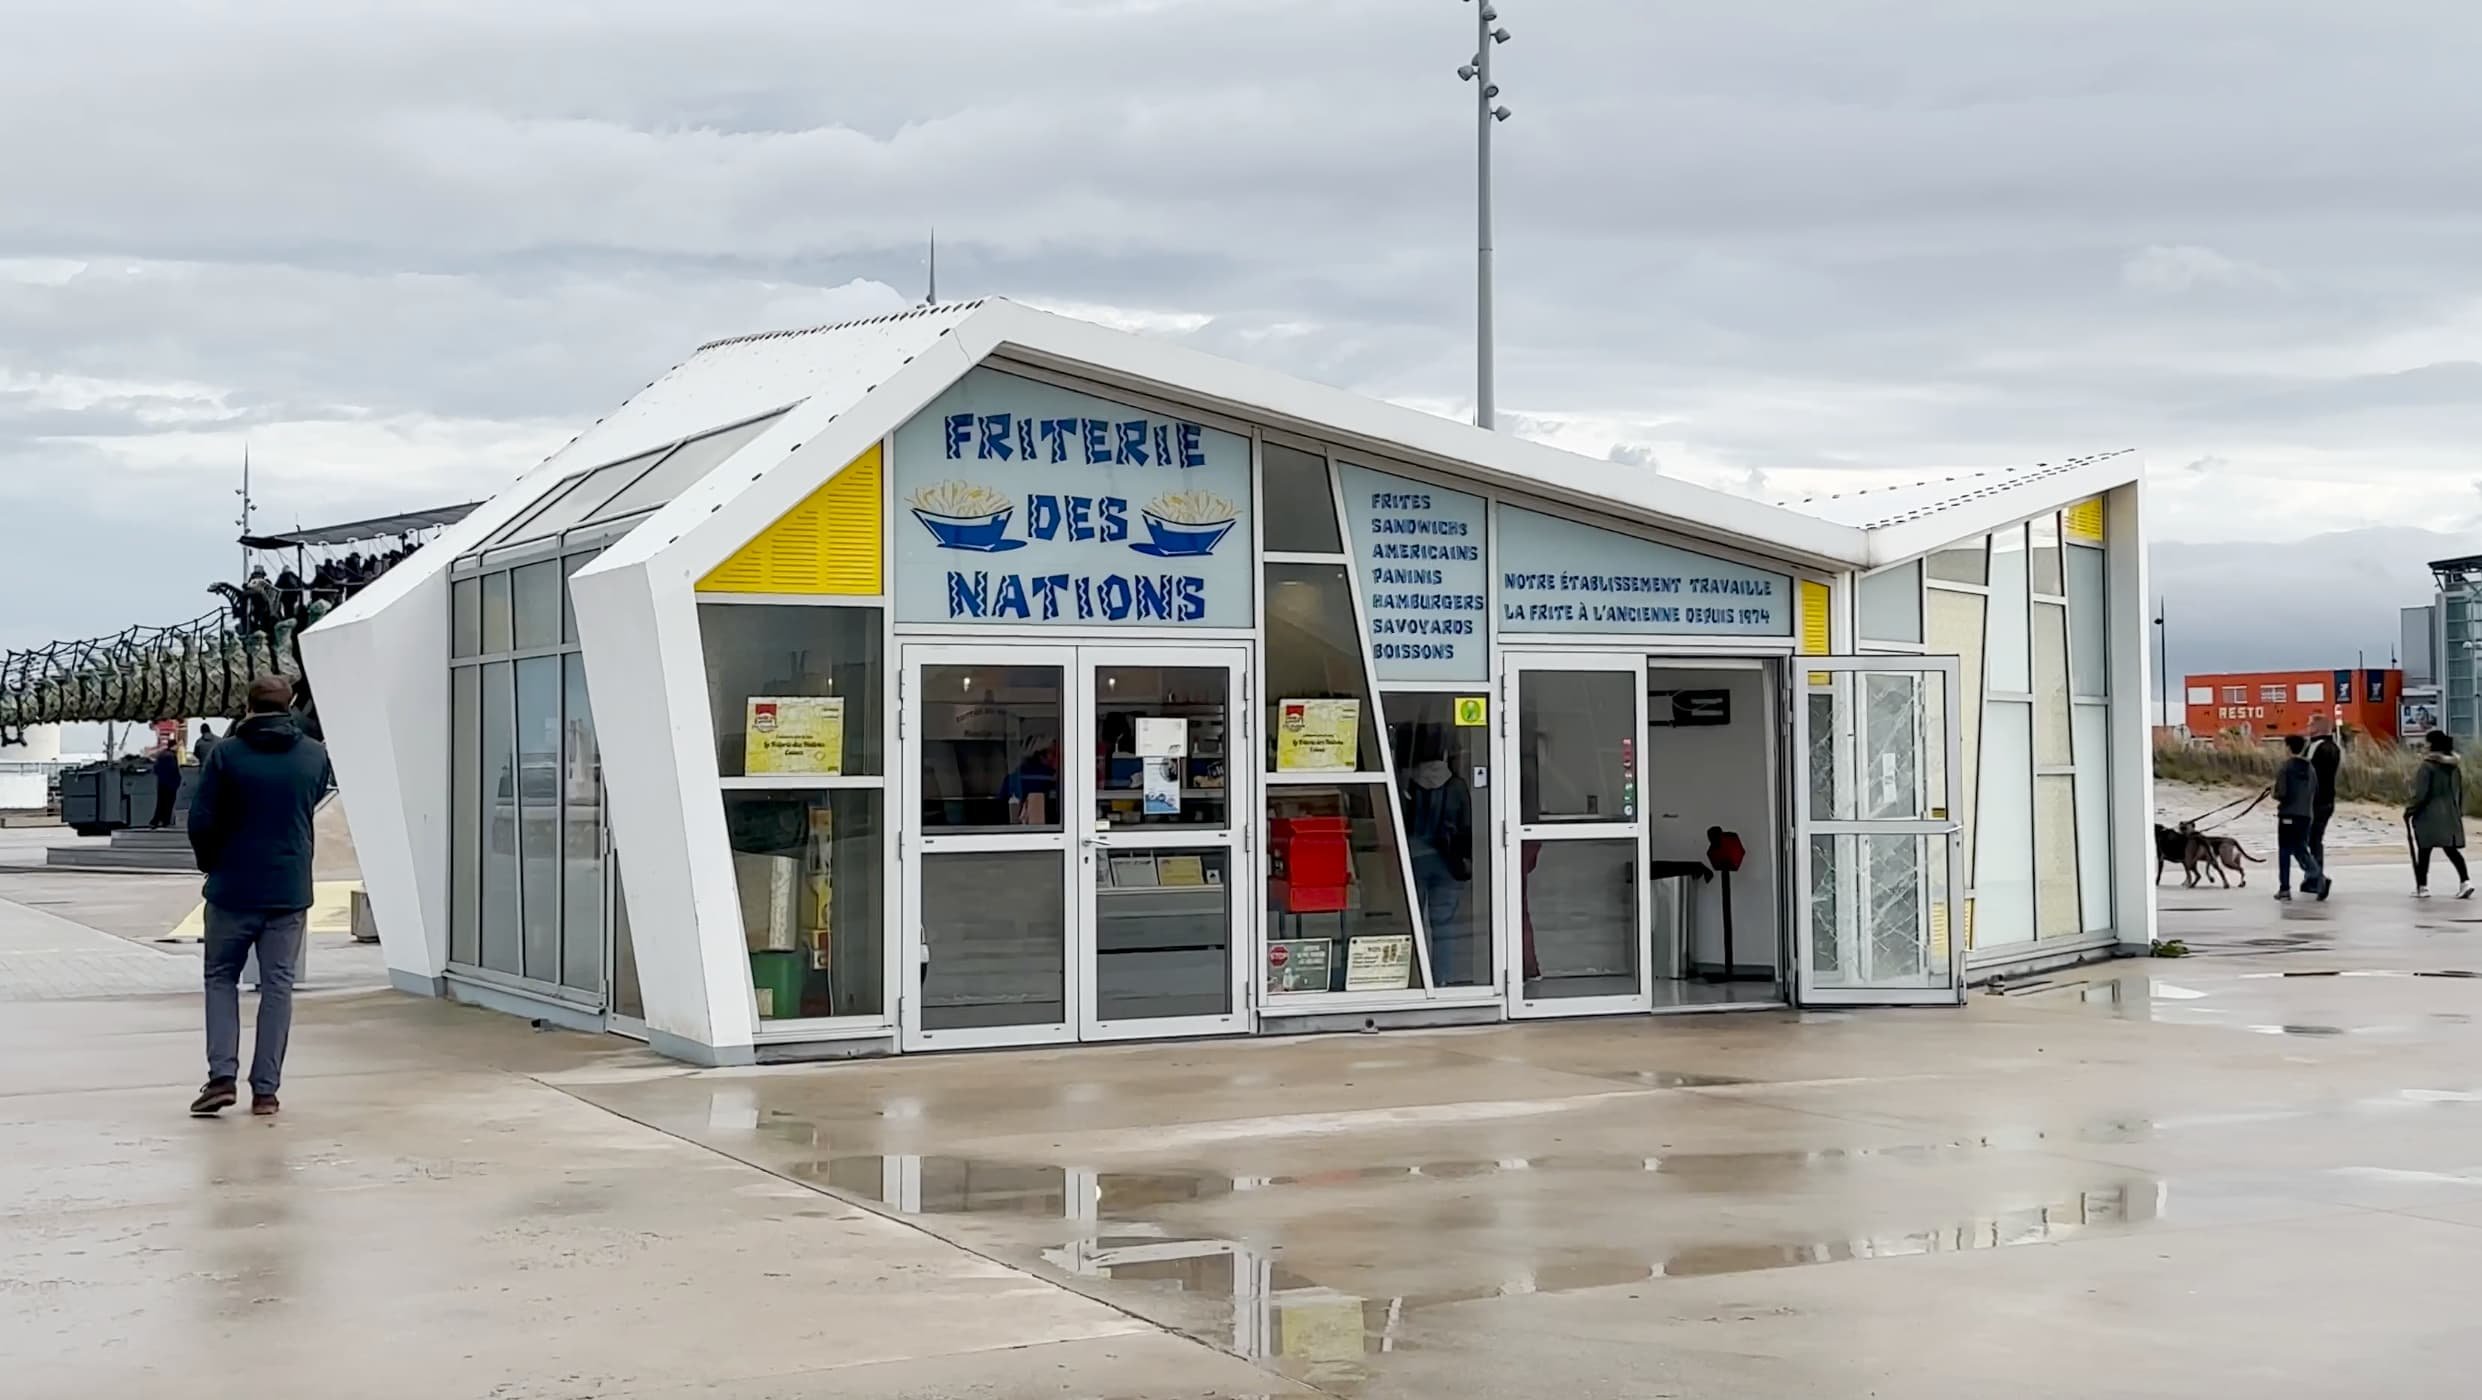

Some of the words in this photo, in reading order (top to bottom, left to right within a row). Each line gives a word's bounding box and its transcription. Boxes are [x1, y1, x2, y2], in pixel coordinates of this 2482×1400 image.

[945, 413, 1206, 469] FRITERIE
[1371, 493, 1431, 510] FRITES
[1027, 493, 1128, 543] DES
[1372, 543, 1478, 561] AMERICAINS
[1372, 568, 1442, 585] PANINIS
[1504, 573, 1555, 590] NOTRE
[1560, 570, 1681, 594] ÉTABLISSEMENT
[1689, 577, 1773, 596] TRAVAILLE
[947, 570, 1206, 622] NATIONS
[1372, 593, 1484, 611] HAMBURGERS
[1504, 604, 1526, 621] LA
[1529, 604, 1573, 621] FRITE
[1578, 601, 1589, 621] À
[1593, 605, 1681, 622] L'ANCIENNE
[1685, 607, 1735, 624] DEPUIS
[1738, 608, 1771, 625] 1974
[1373, 618, 1473, 635] SAVOYARDS
[1373, 643, 1454, 660] BOISSONS
[2218, 706, 2265, 720] RESTO
